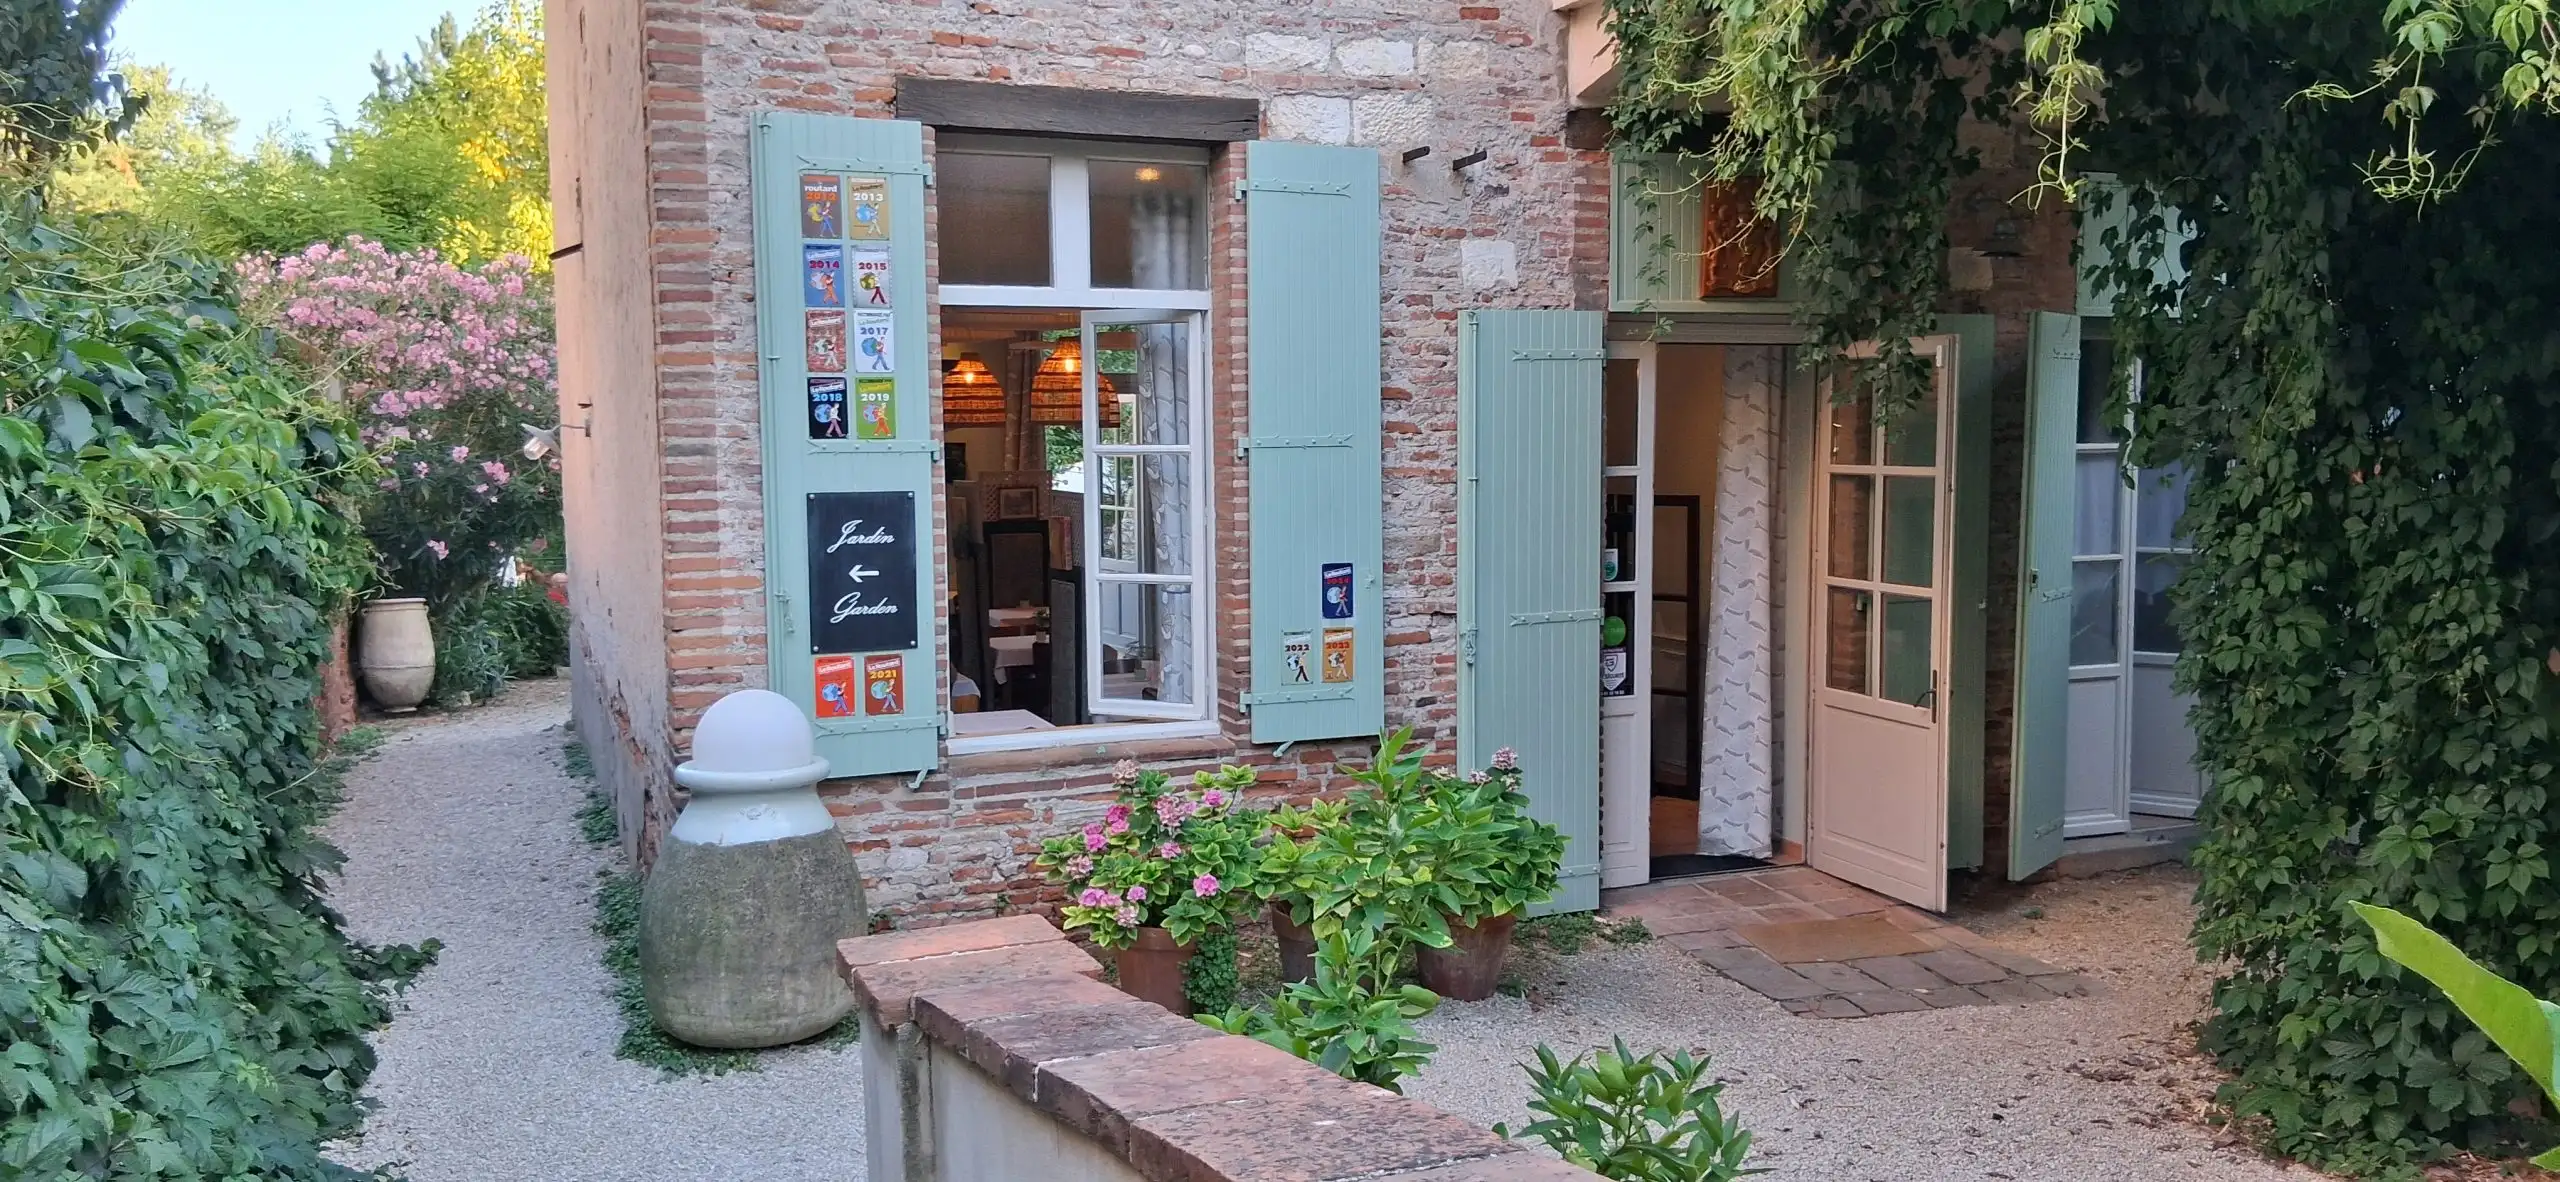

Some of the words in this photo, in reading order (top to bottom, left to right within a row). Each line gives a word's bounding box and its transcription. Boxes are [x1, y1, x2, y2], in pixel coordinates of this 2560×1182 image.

[804, 184, 838, 192] routard
[853, 192, 884, 202] 2013
[809, 260, 840, 269] 2014
[858, 262, 887, 270] 2015
[860, 326, 889, 335] 2017
[812, 393, 843, 402] 2018
[861, 393, 890, 402] 2019
[827, 519, 895, 554] Jardin
[830, 591, 898, 624] Garden
[1285, 644, 1310, 652] 2022
[869, 669, 897, 679] 2021
